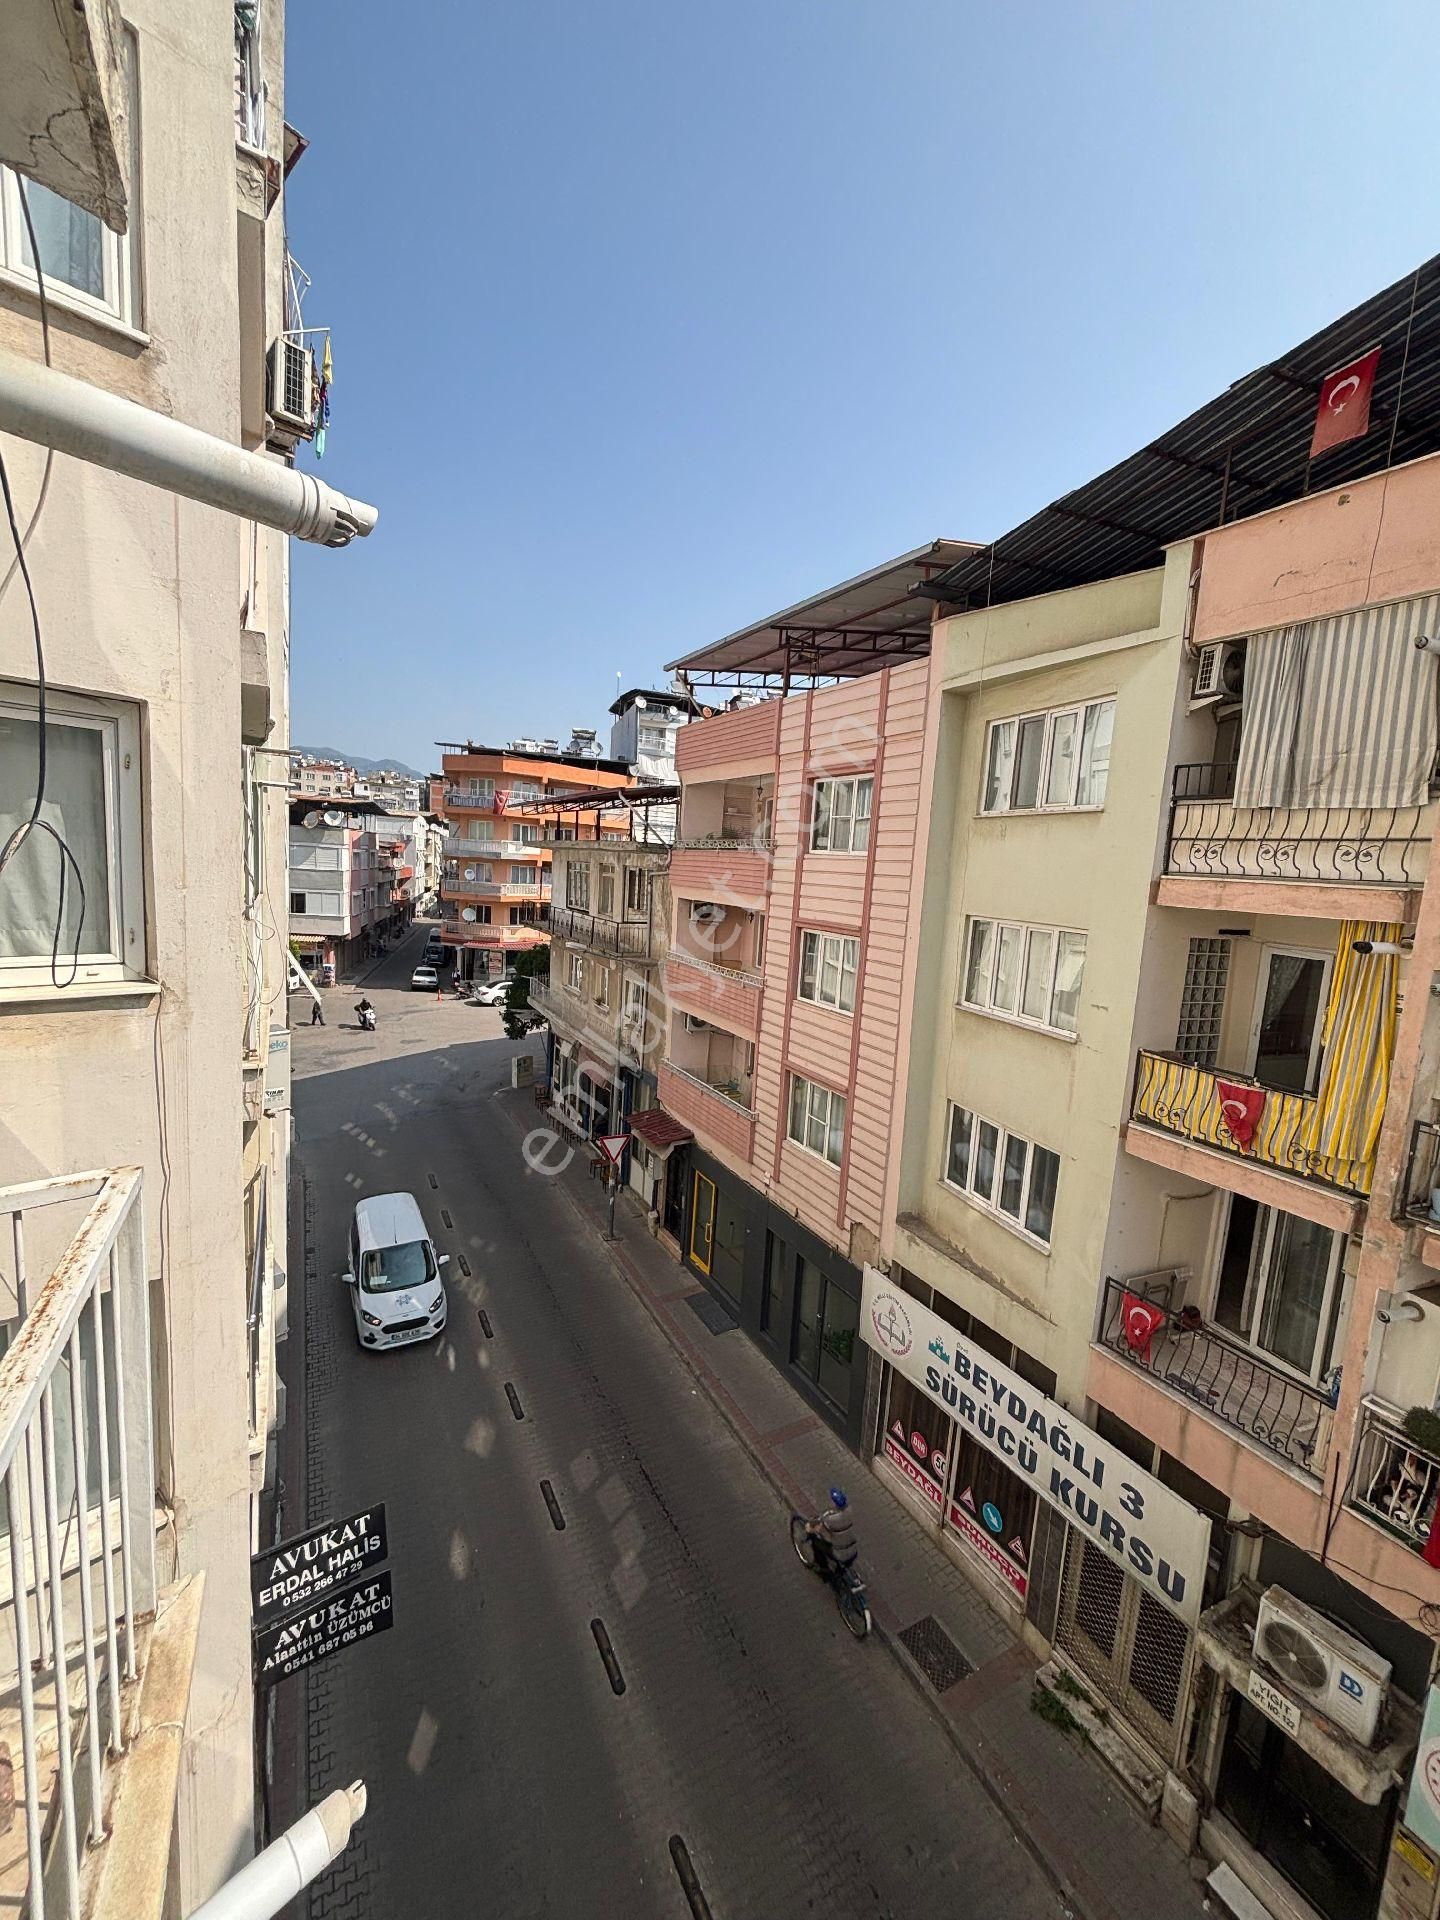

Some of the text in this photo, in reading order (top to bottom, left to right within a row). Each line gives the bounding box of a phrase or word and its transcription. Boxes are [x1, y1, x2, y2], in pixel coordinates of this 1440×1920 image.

[269, 1040, 288, 1050] eko
[912, 1438, 926, 1453] DUR
[955, 1349, 1145, 1520] BEYDAĞLI 3
[886, 1442, 941, 1504] BEYDAĞL
[925, 1365, 1186, 1603] SÜRÜCÜ KURSU
[259, 1534, 381, 1607] ERDAL HALİS
[269, 1514, 371, 1581] AVUKAT
[262, 1596, 392, 1671] Alaattin ÜZÜMCÜ
[274, 1583, 380, 1650] AVUKAT
[284, 1652, 315, 1673] 0541
